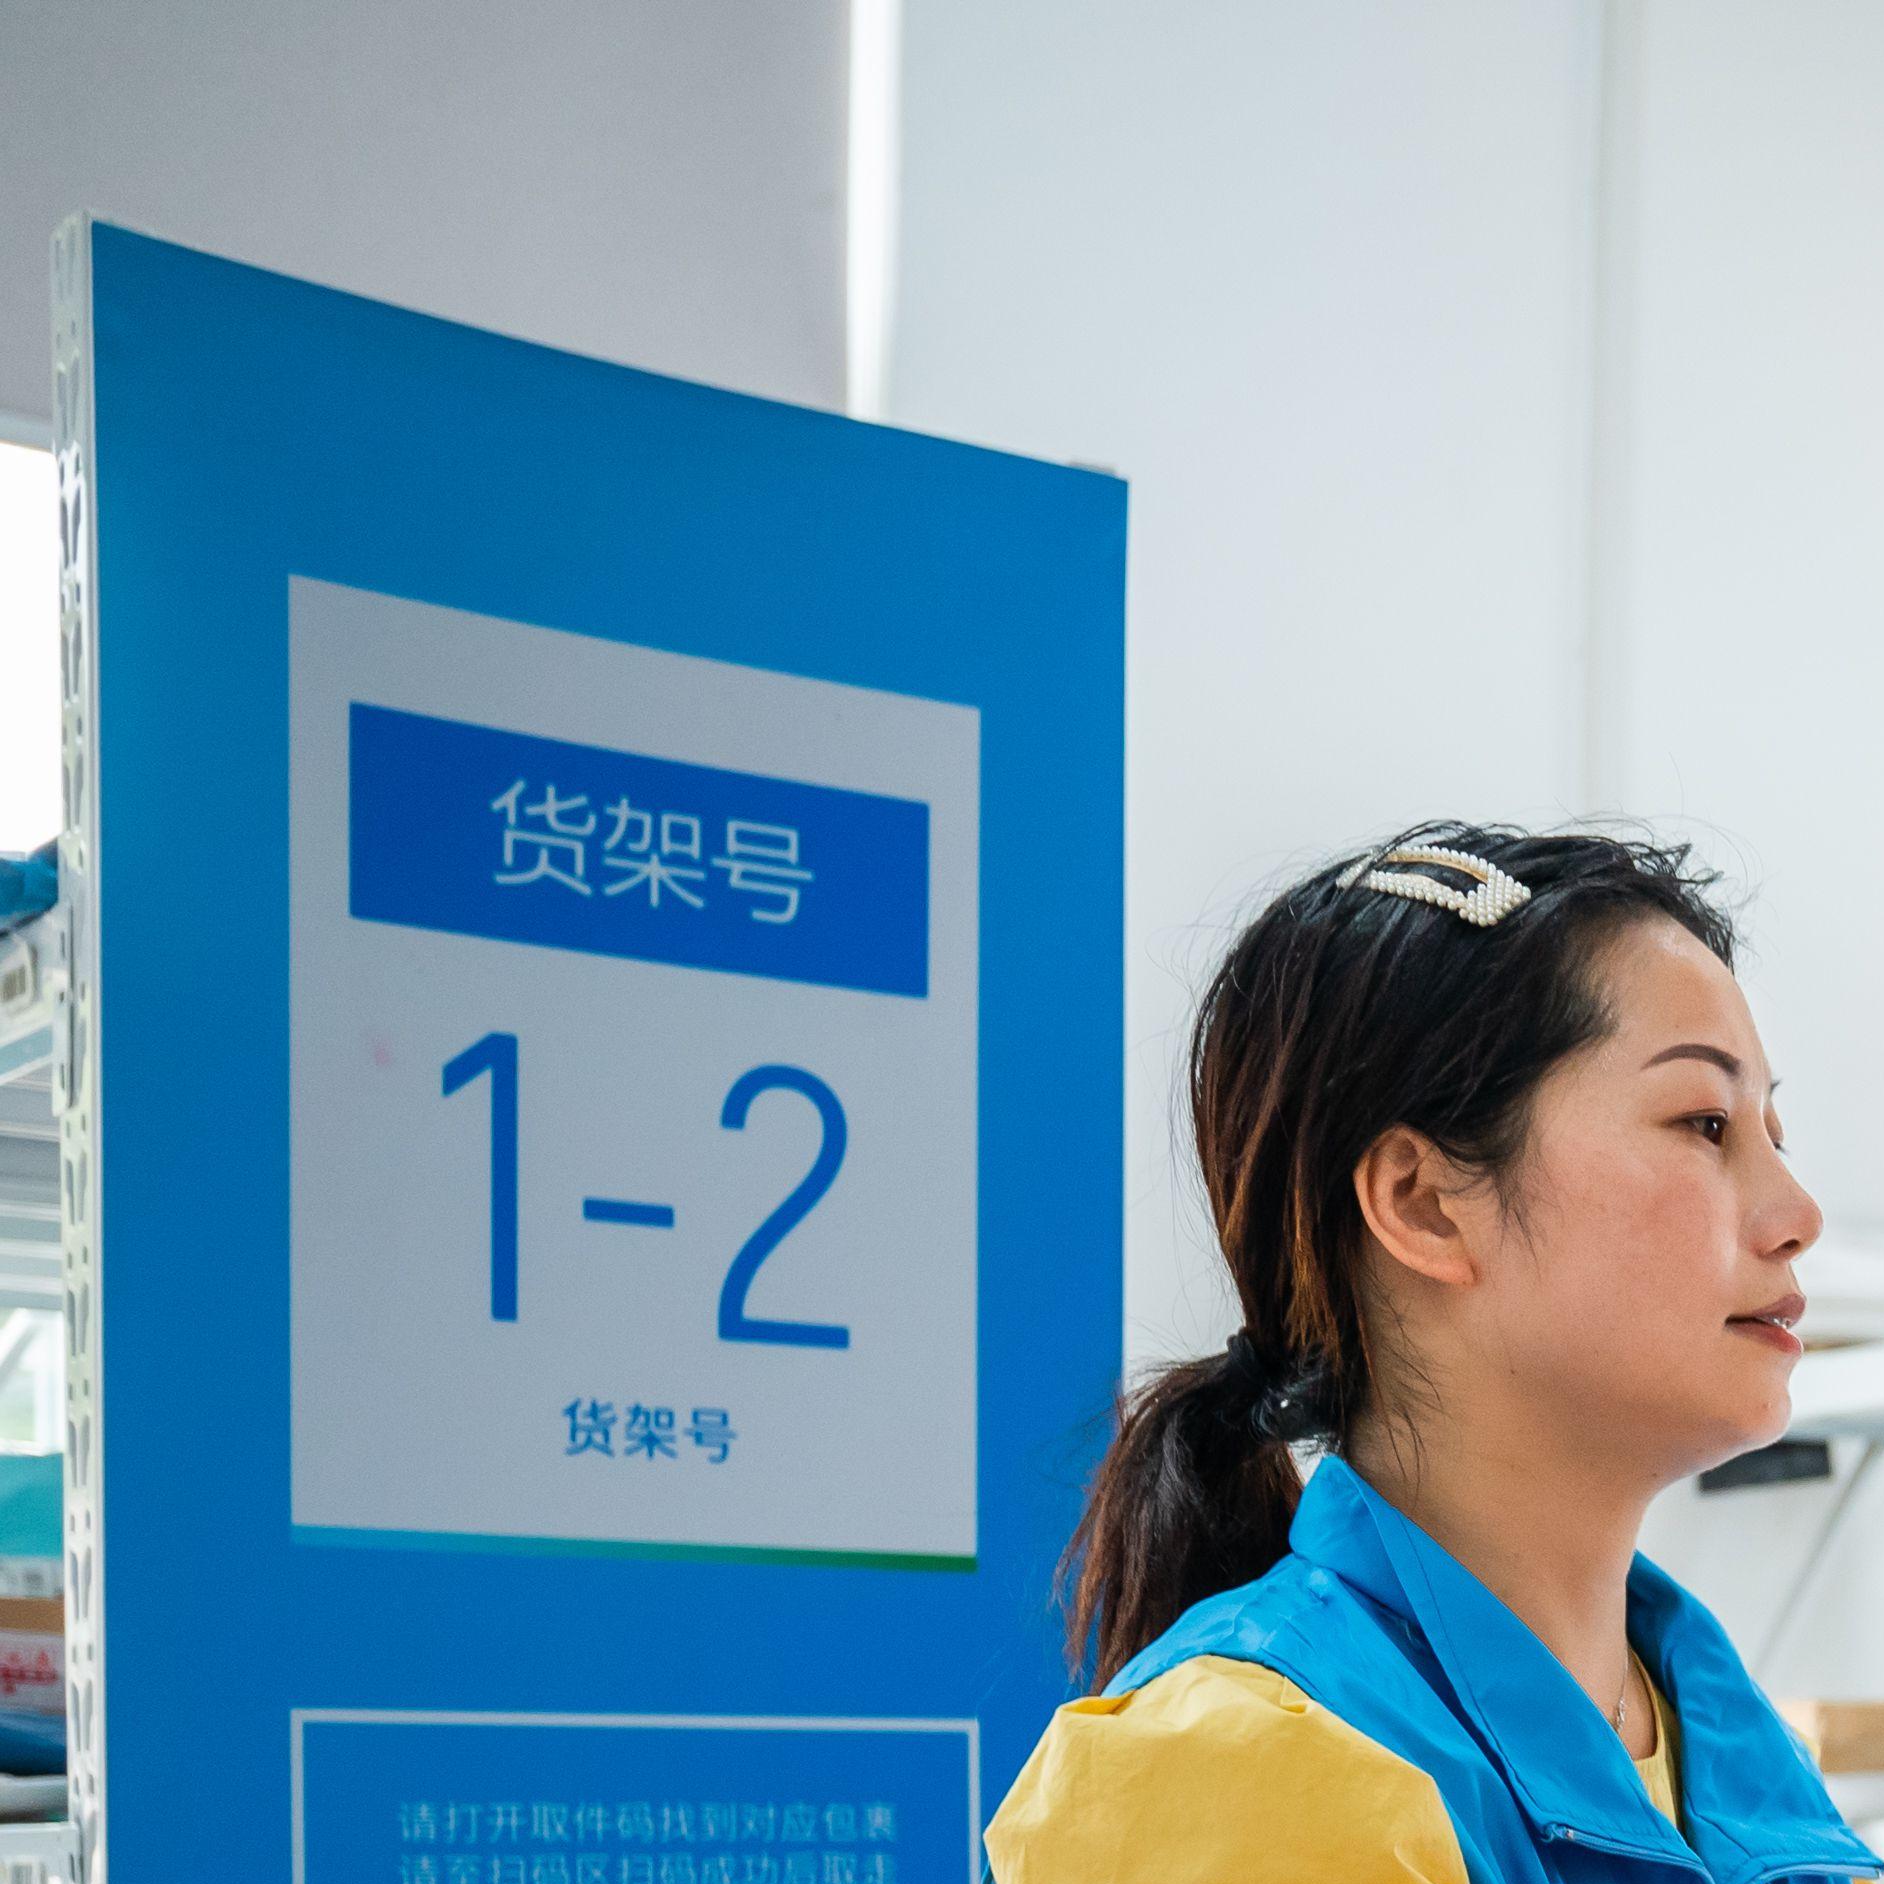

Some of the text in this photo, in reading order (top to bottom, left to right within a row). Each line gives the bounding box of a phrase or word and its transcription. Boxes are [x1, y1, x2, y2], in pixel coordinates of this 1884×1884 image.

[490, 779, 814, 924] 货架号
[441, 1031, 849, 1349] 1-2
[562, 1398, 738, 1463] 货架号
